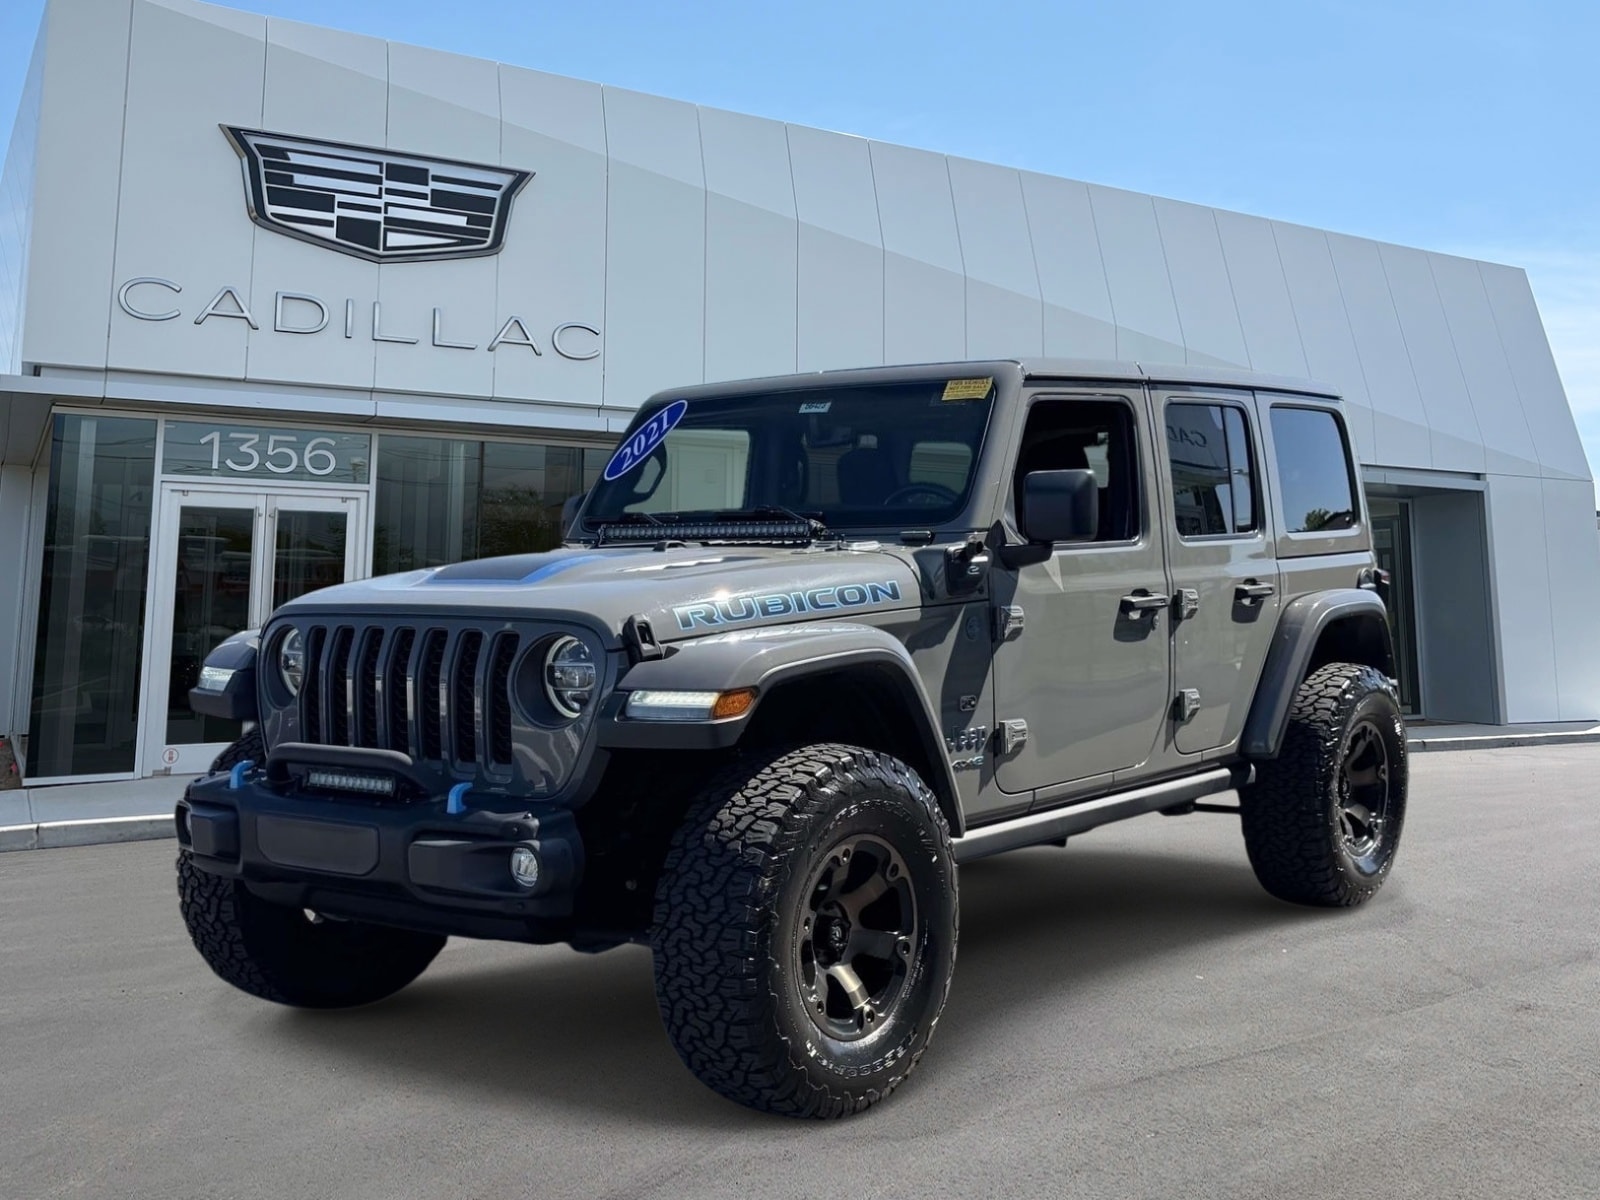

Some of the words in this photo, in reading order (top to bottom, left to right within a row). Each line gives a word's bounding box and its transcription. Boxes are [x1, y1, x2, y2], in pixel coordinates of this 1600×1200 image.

[118, 277, 600, 360] CADILLAC
[200, 431, 336, 475] 1356
[621, 410, 670, 471] 2021
[673, 580, 901, 630] RUBICON
